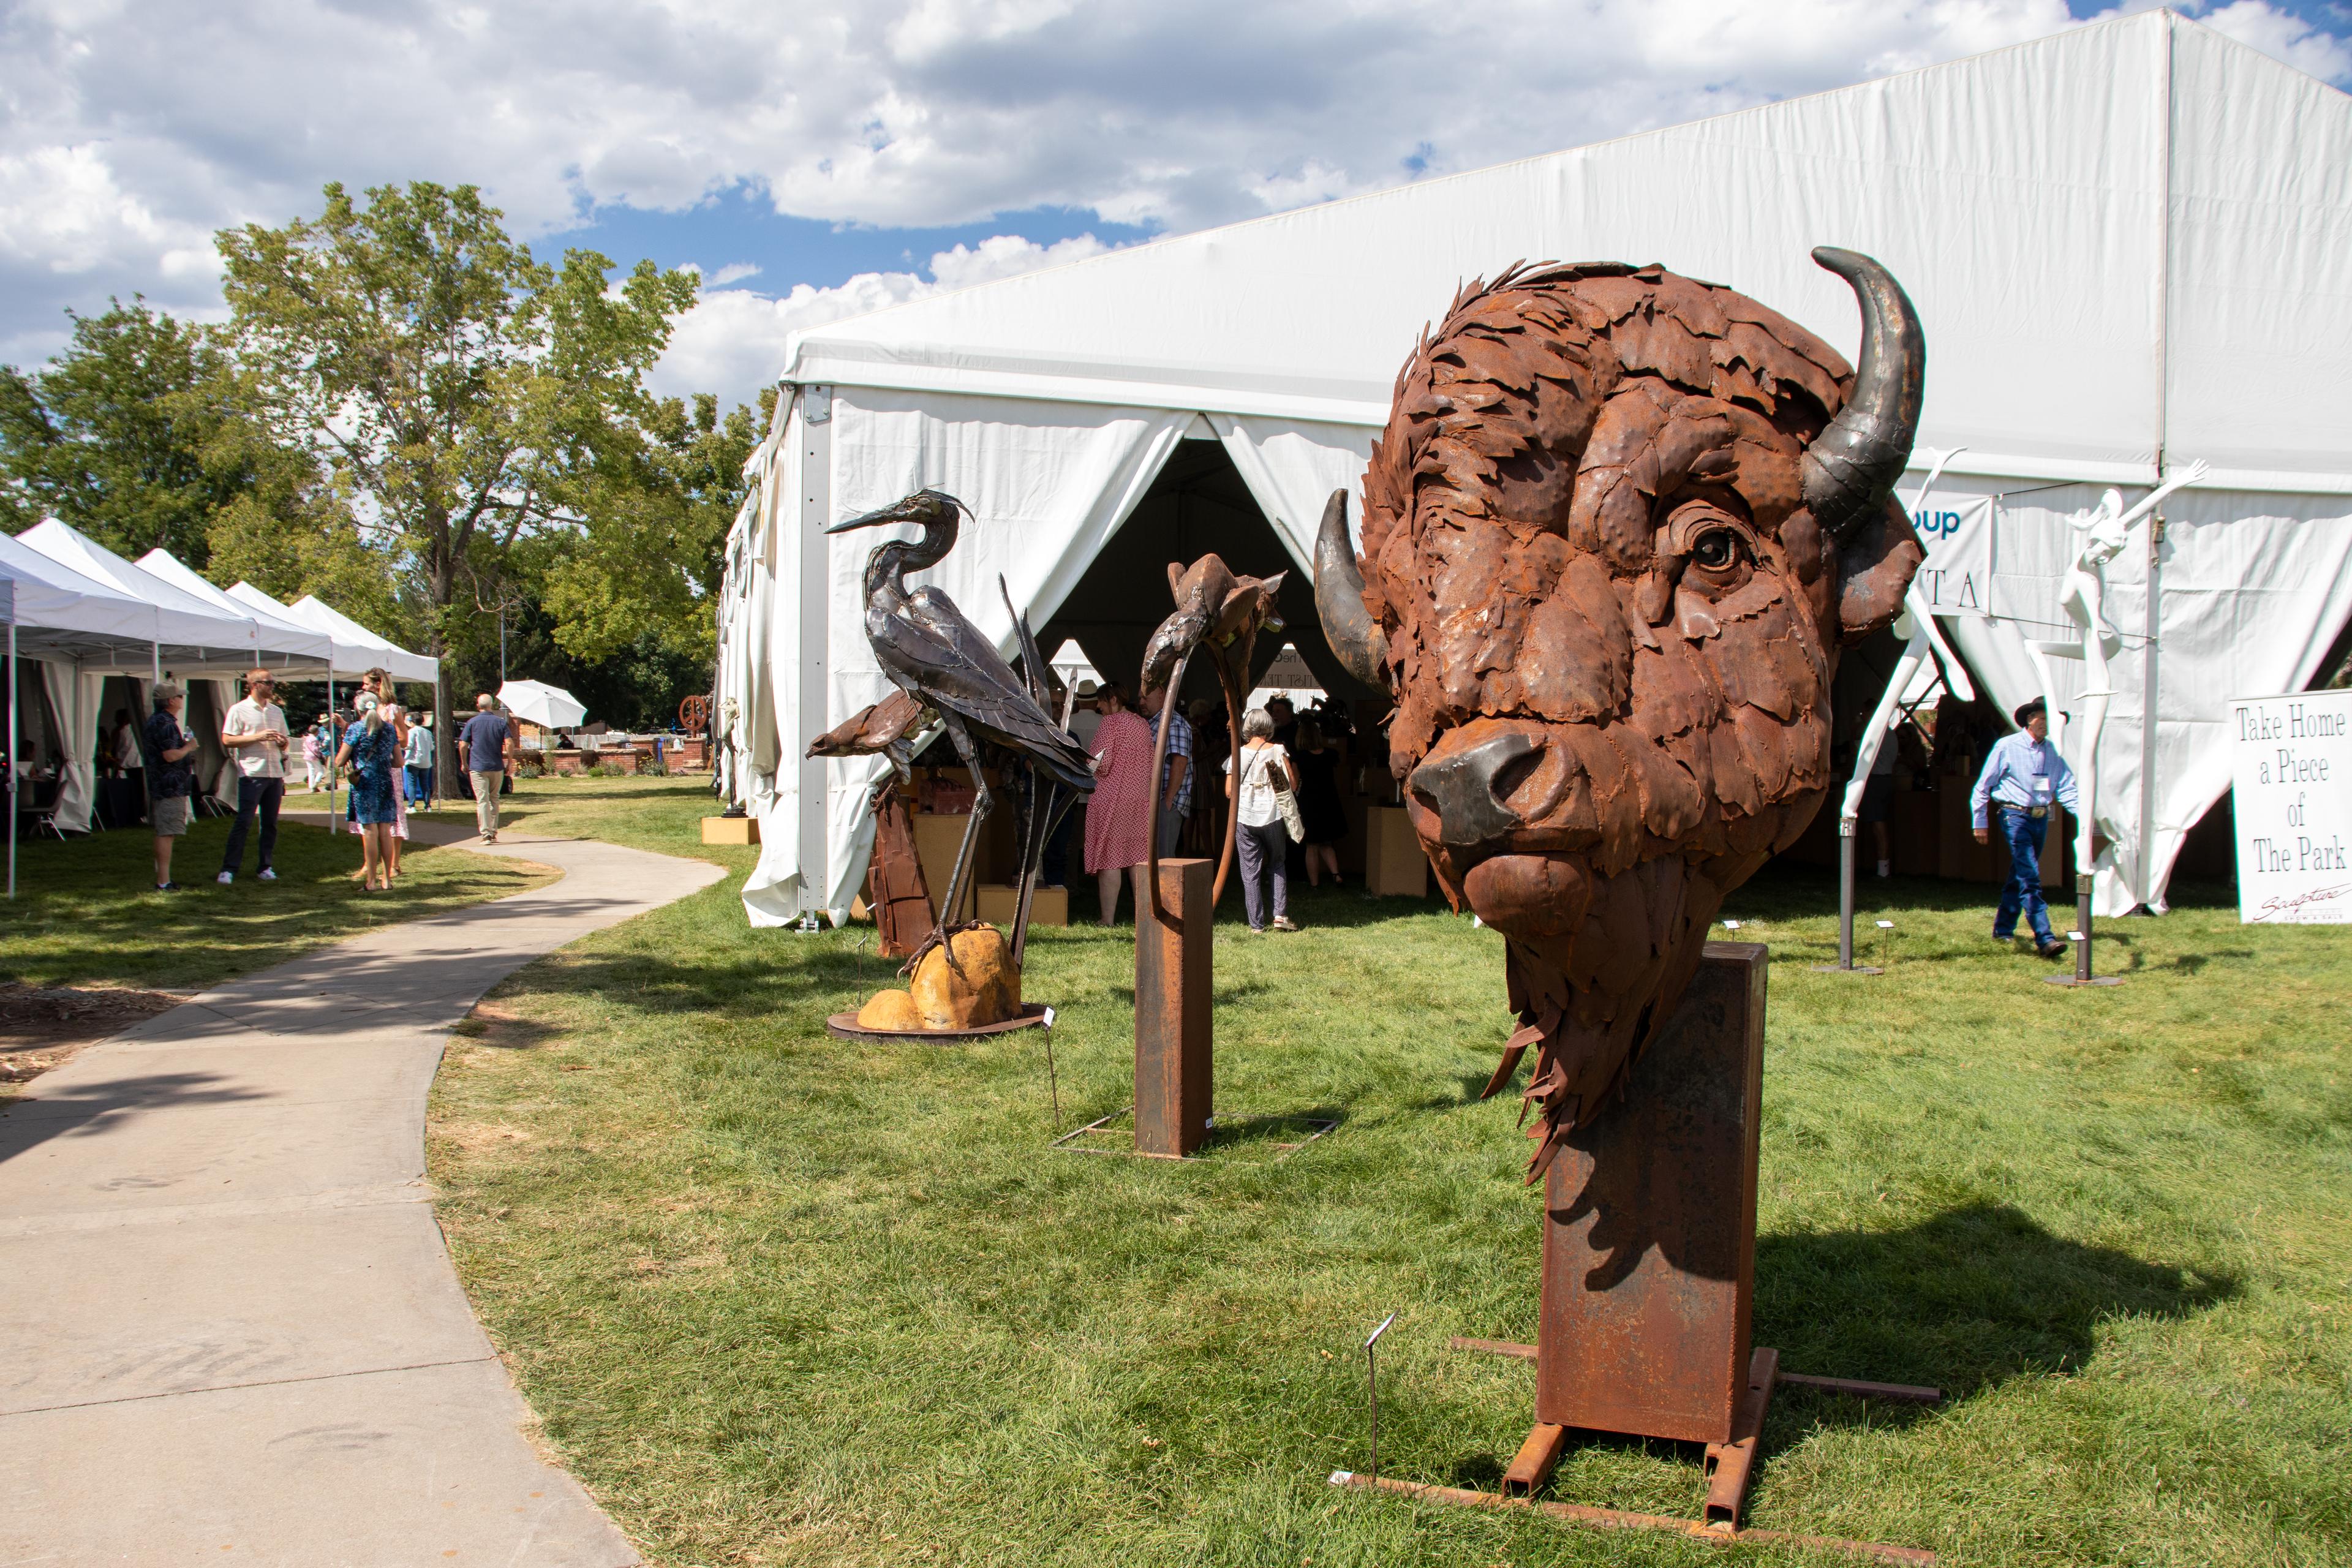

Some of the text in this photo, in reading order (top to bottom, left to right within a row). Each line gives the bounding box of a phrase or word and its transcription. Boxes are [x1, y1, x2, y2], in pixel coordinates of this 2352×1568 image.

[1921, 568, 1980, 608] TA
[2236, 704, 2345, 741] Take Home
[2260, 748, 2329, 784] a Piece
[2288, 792, 2305, 827] of
[2253, 835, 2346, 872] The Park
[2253, 883, 2352, 920] Sculpture
